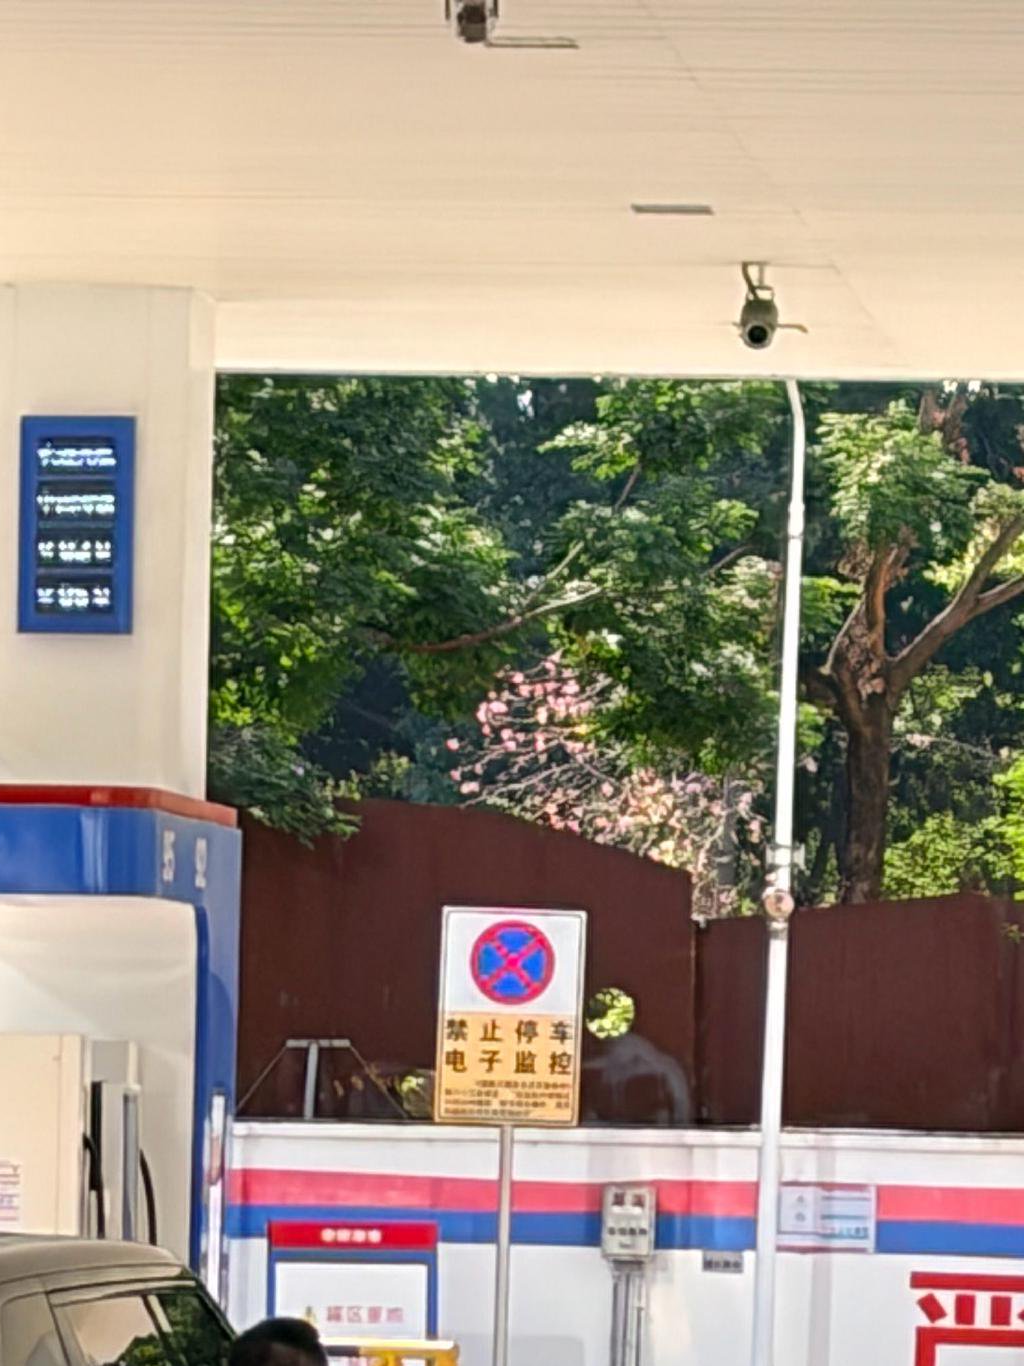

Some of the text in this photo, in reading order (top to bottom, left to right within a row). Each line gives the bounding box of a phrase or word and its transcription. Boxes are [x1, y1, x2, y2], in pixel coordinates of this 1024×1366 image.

[446, 1019, 573, 1044] 禁止停车
[445, 1049, 572, 1076] 电子监控
